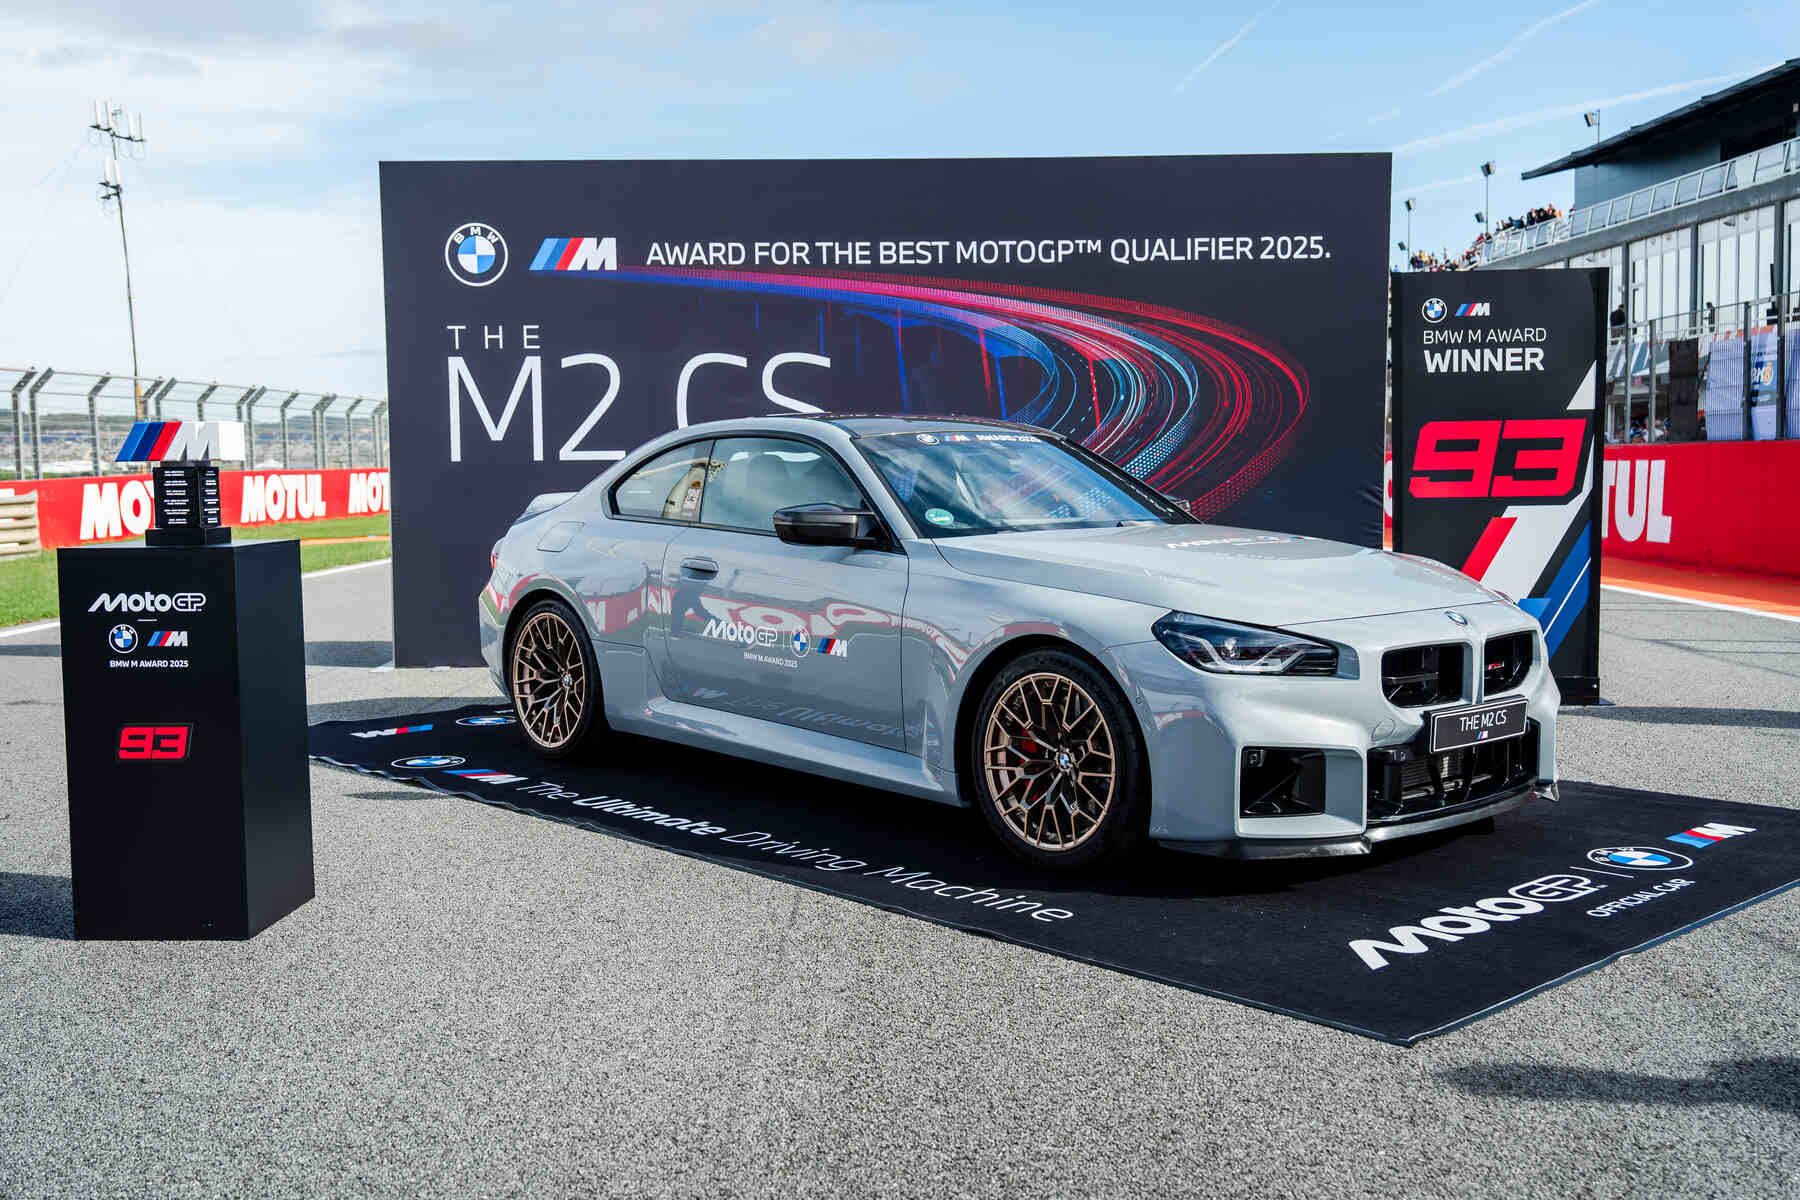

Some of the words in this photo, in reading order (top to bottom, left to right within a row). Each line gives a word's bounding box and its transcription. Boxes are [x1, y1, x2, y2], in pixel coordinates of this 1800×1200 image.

[646, 241, 746, 266] AWARD
[754, 241, 811, 266] FOR
[815, 241, 871, 265] THE
[879, 240, 950, 265] BEST
[1110, 237, 1254, 265] QUALIFIER
[1259, 235, 1331, 260] 2025.
[446, 324, 541, 350] THE
[1423, 329, 1464, 345] BMW
[1468, 329, 1482, 343] M
[1486, 327, 1548, 343] AWARD
[1423, 347, 1545, 373] WINNER
[447, 352, 627, 462] M2
[1408, 418, 1588, 499] 93
[240, 474, 327, 523] MOTUL
[88, 592, 207, 613] MotoGP
[702, 618, 778, 647] MotoGP
[110, 659, 129, 668] BMW
[130, 659, 138, 668] M
[139, 659, 168, 668] AWARD
[169, 659, 189, 668] 2025
[1459, 714, 1481, 732] THE
[1481, 711, 1494, 728] M2
[1495, 709, 1508, 726] CS
[117, 726, 189, 760] 93
[515, 781, 579, 800] The
[572, 795, 727, 835] Ultimate
[720, 831, 869, 871] Driving
[863, 865, 1075, 923] Machine
[1586, 889, 1667, 918] OFFICIAL
[1652, 878, 1697, 893] CAR
[1348, 873, 1602, 971] MotoGP
